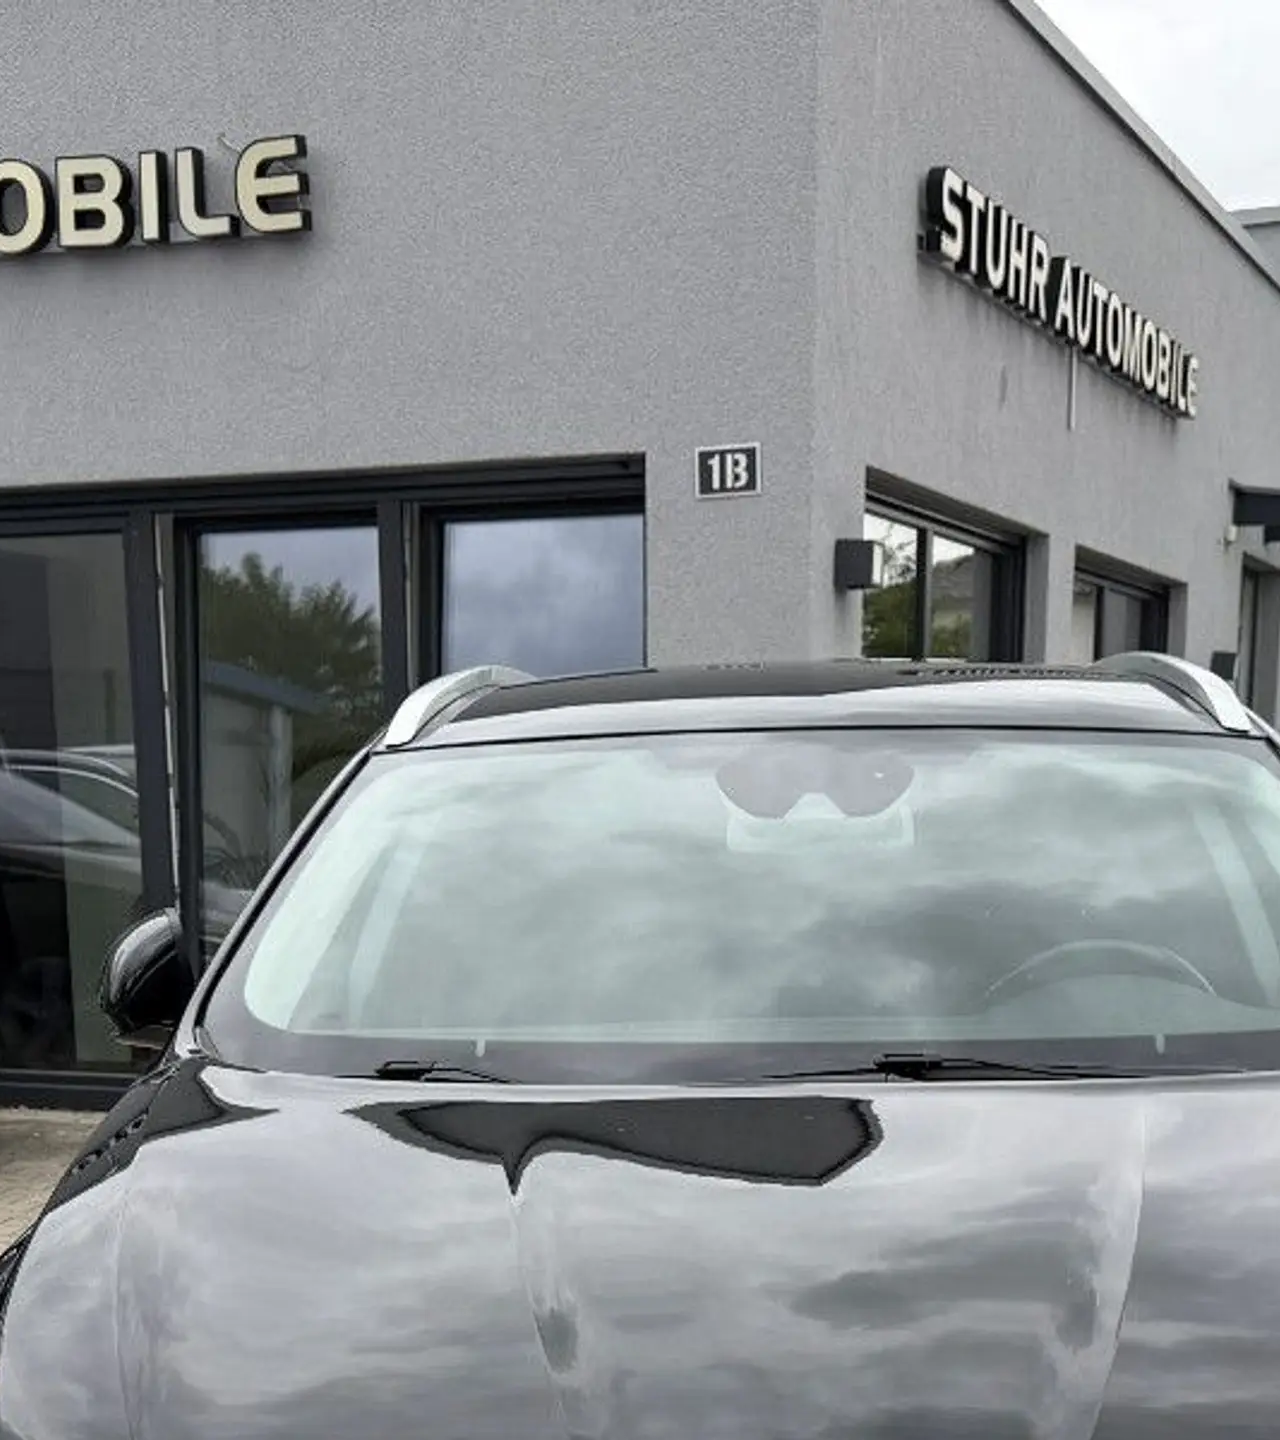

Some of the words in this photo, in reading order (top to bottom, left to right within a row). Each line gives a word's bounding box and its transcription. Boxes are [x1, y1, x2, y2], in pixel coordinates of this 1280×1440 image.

[928, 167, 1050, 322] STUHR
[1054, 256, 1199, 418] AUTOMOBILE
[706, 452, 749, 490] 1B
